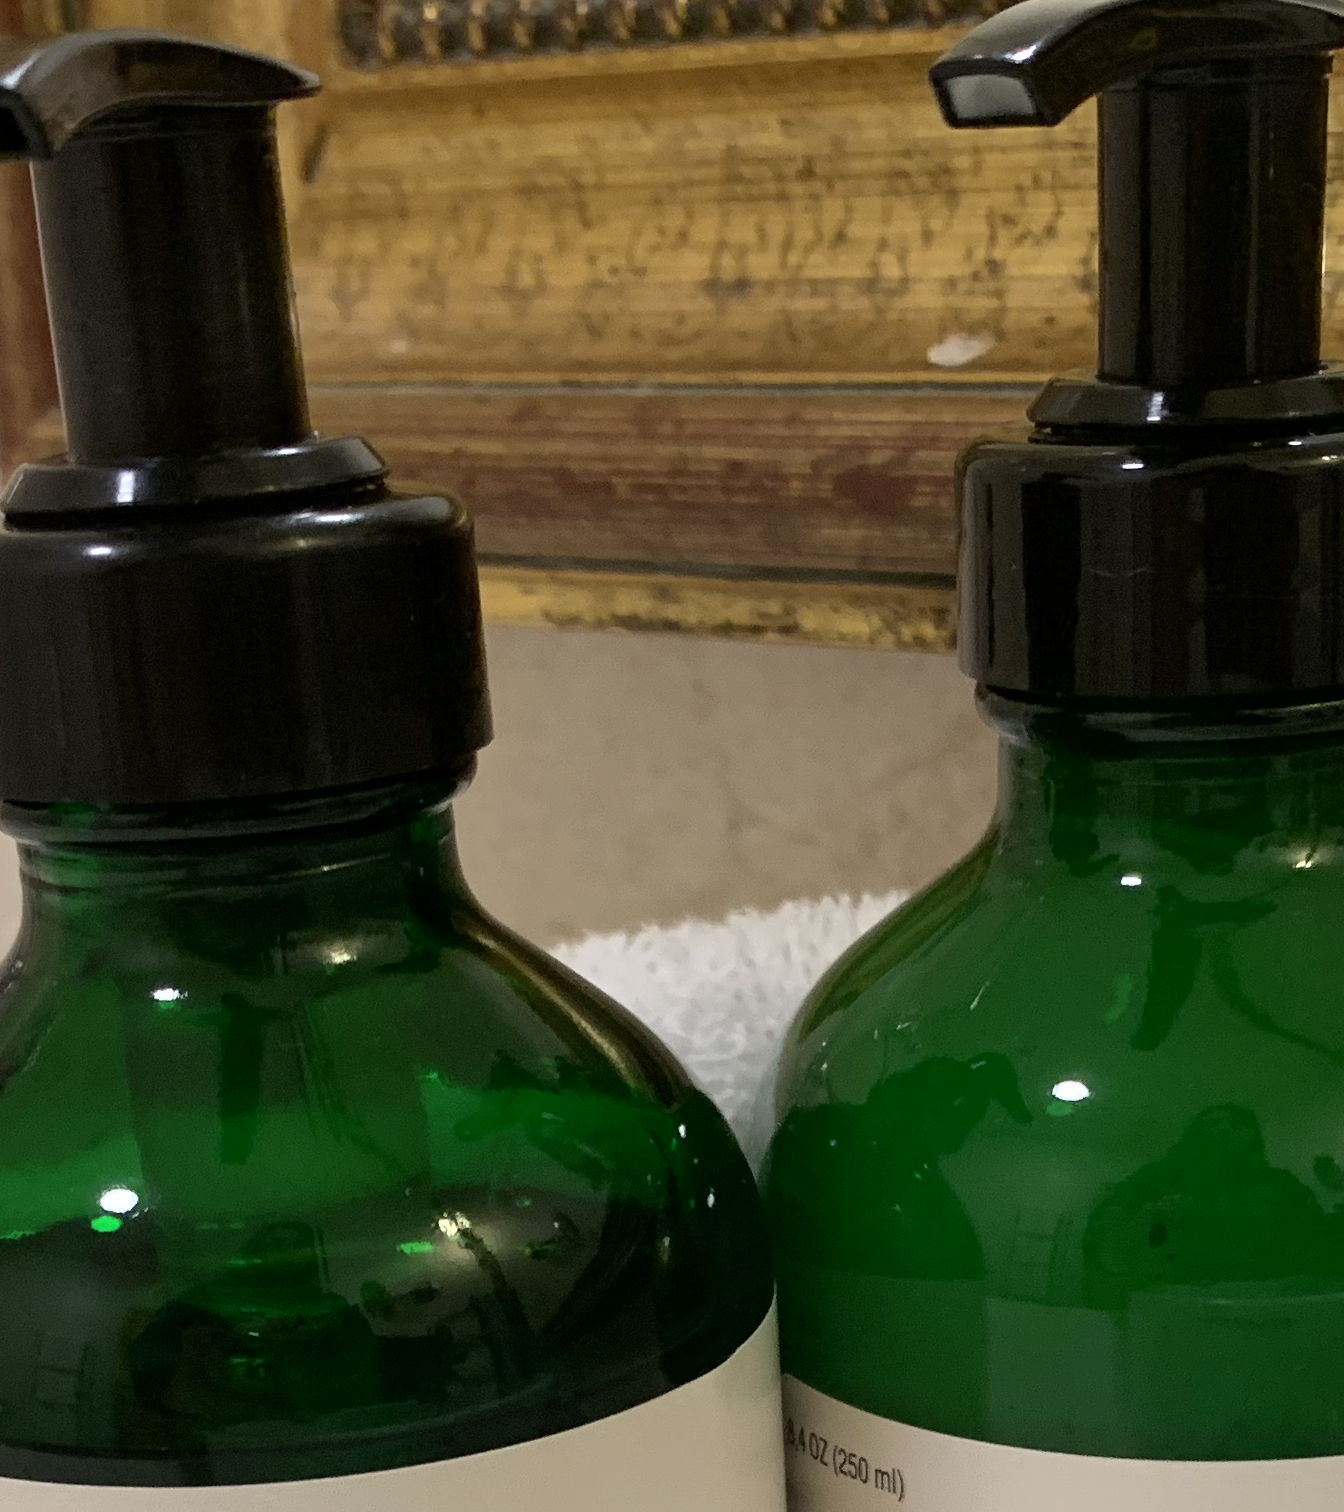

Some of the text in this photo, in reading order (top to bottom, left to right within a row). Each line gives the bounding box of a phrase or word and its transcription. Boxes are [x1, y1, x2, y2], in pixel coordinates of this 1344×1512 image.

[809, 1432, 828, 1467] OZ
[833, 1445, 869, 1484] (250
[874, 1468, 905, 1502] ml)
